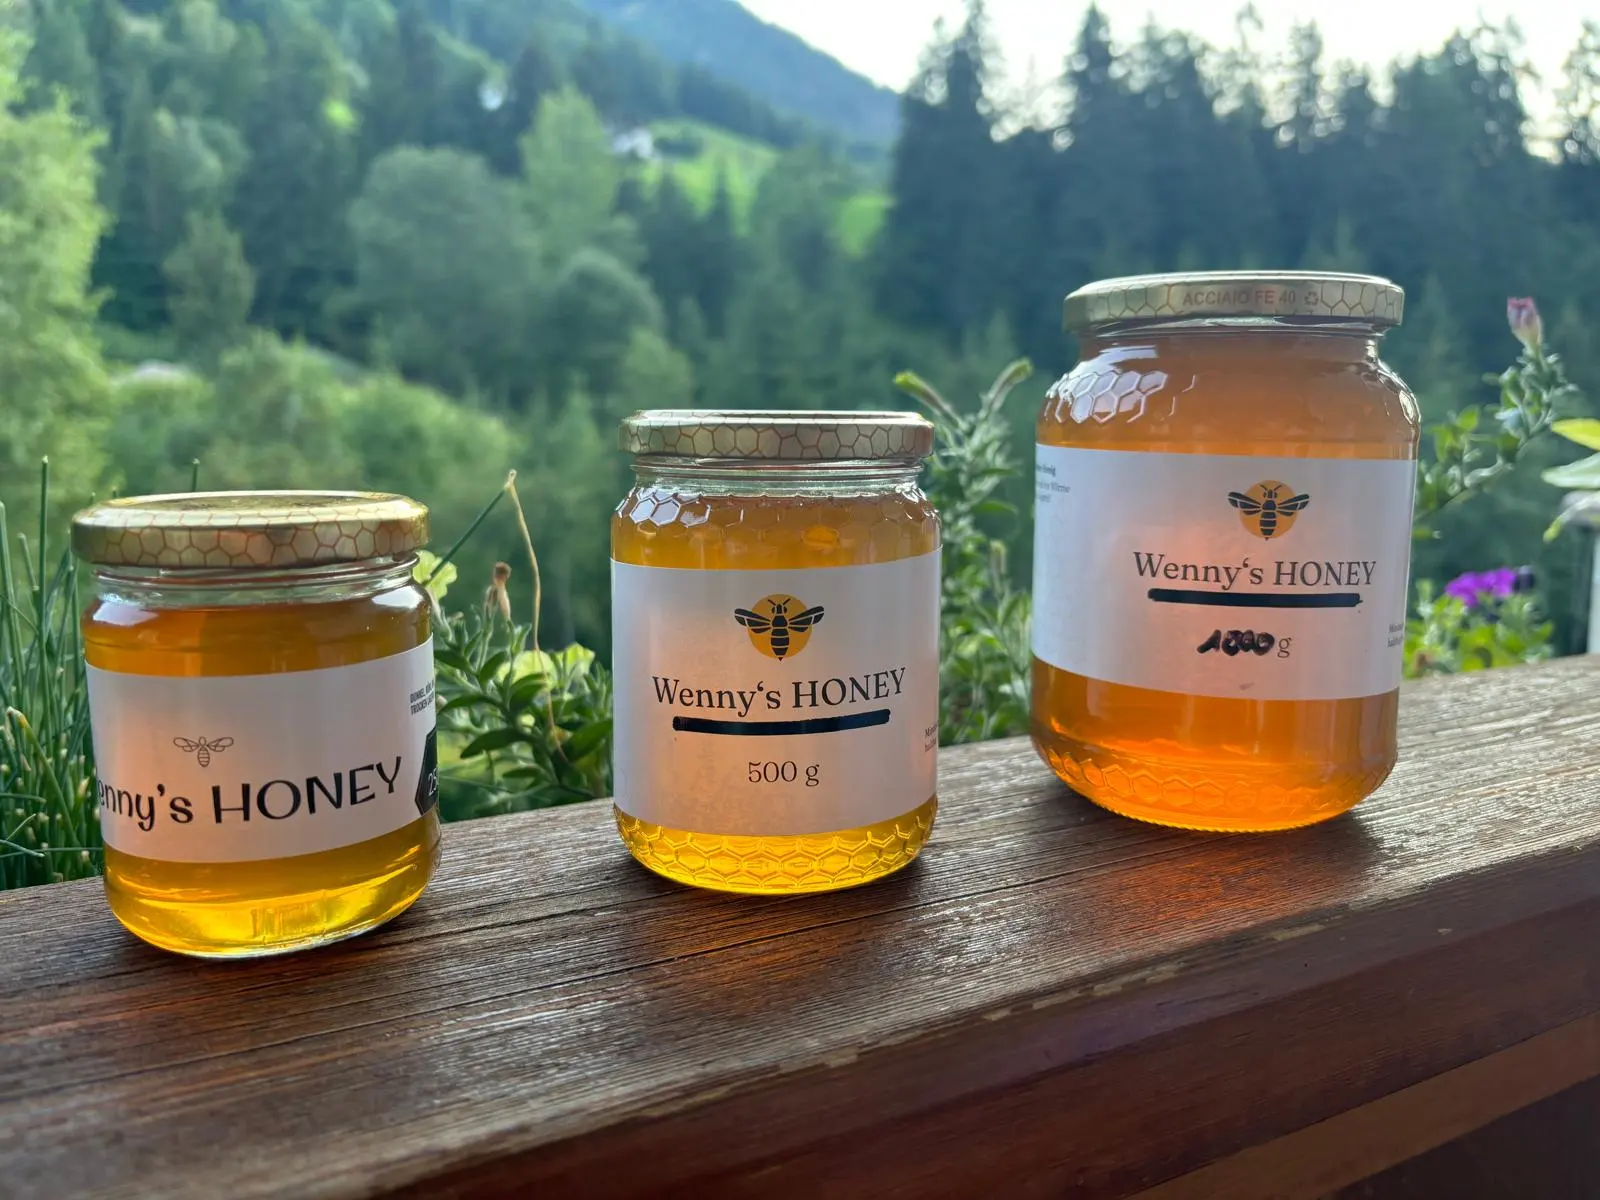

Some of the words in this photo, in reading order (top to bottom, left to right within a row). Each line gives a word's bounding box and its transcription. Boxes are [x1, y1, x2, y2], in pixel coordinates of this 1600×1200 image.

[1183, 290, 1248, 306] ACCIAIO
[1255, 290, 1276, 305] FE
[1278, 289, 1297, 306] 40
[1273, 560, 1377, 587] HONEY
[1277, 637, 1293, 659] g
[791, 667, 906, 709] HONEY
[747, 760, 798, 784] 500
[804, 762, 821, 788] g
[97, 779, 194, 832] enny’s
[211, 756, 402, 824] HONEY
